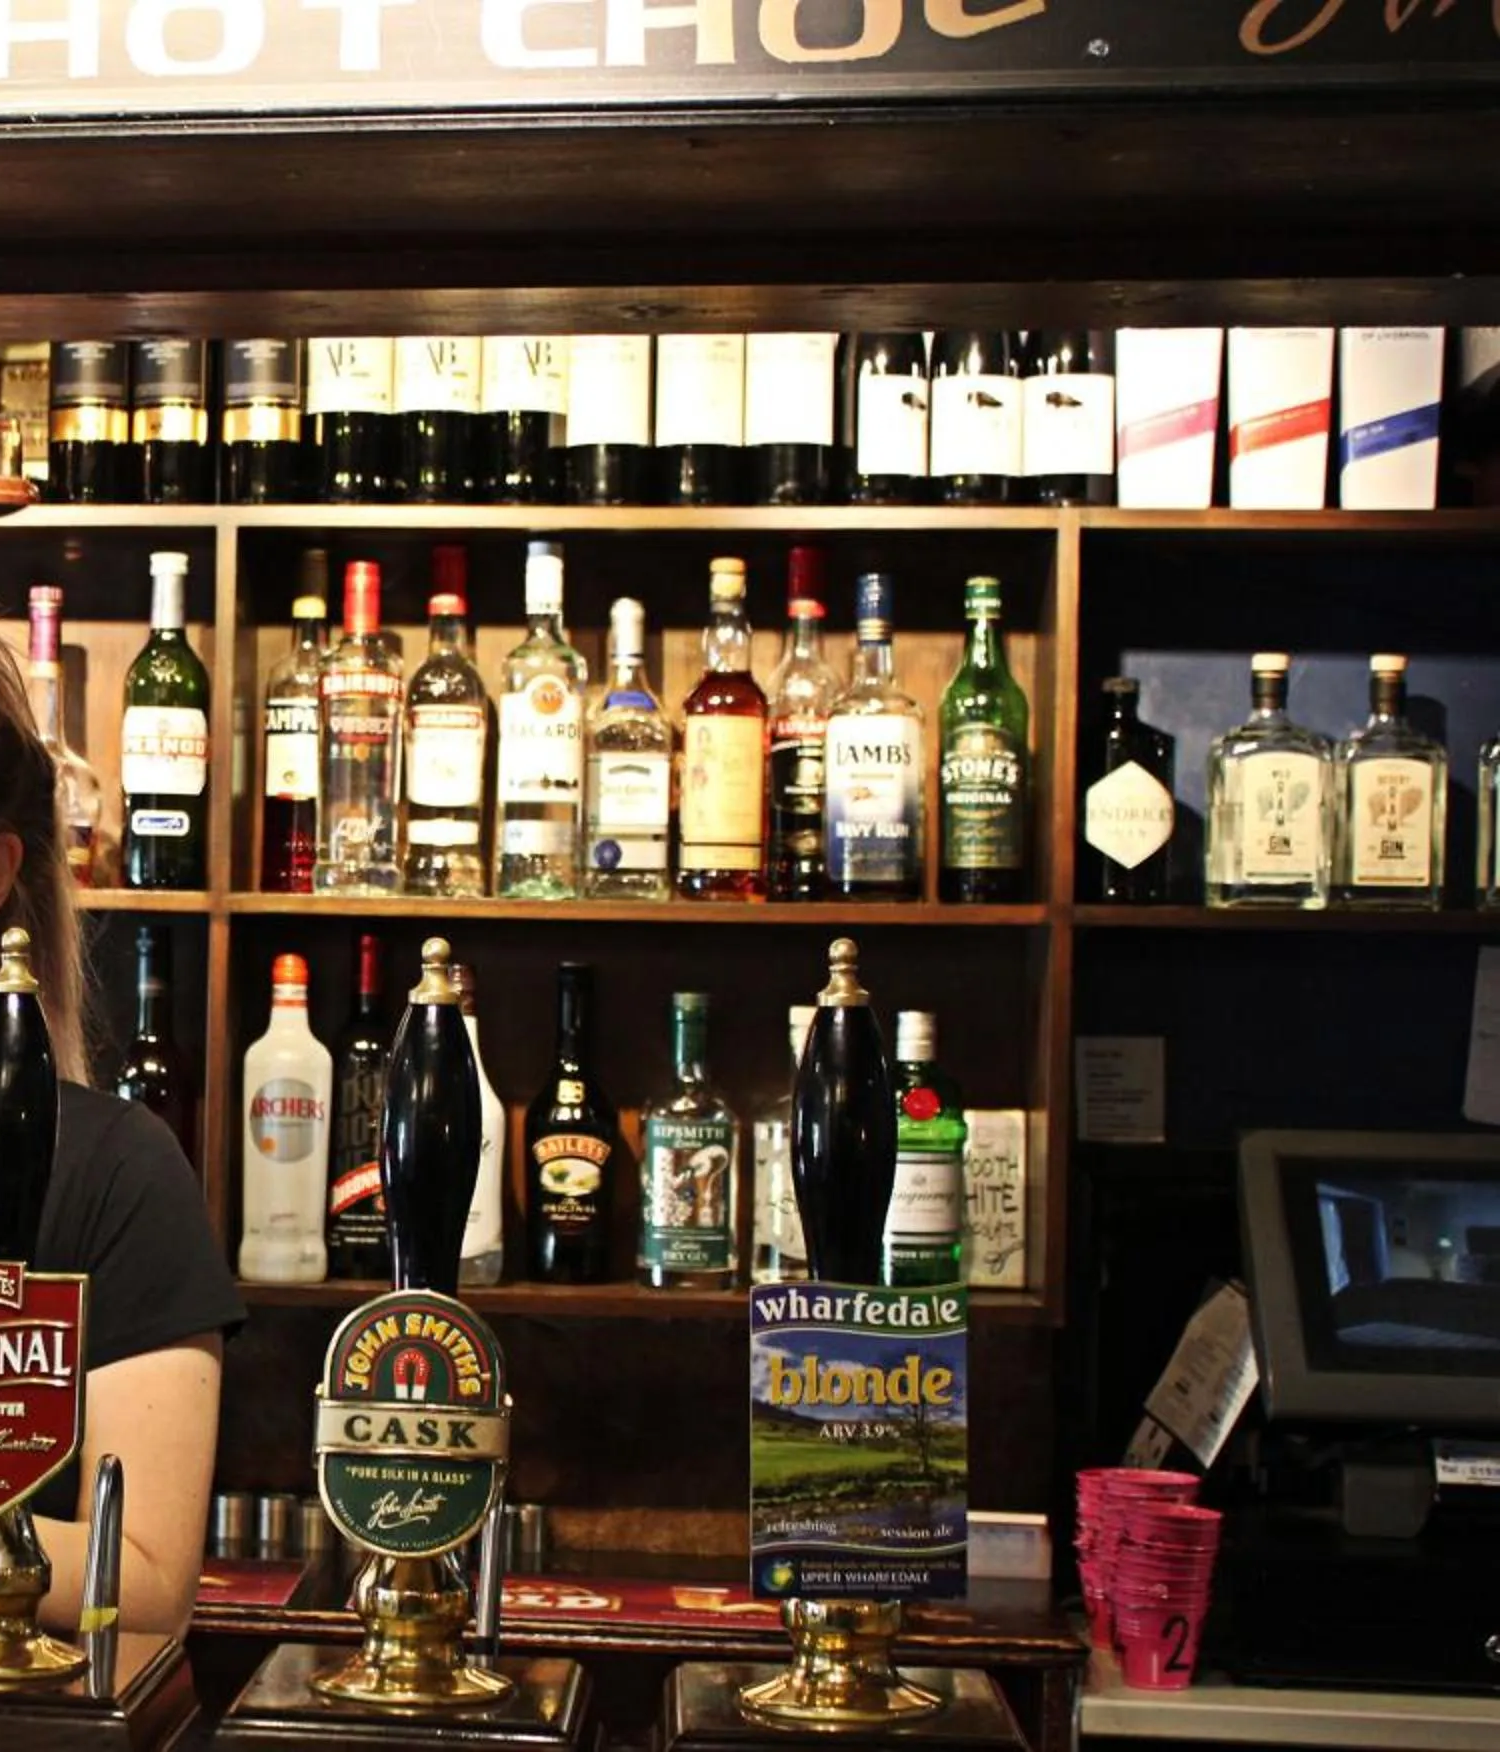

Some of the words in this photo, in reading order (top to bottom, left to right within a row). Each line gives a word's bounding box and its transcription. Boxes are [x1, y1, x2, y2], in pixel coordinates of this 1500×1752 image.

[265, 707, 319, 732] AMPA
[836, 741, 912, 766] LAMB'S
[250, 1096, 326, 1121] ARCHERS
[965, 1182, 1019, 1215] HITE
[755, 1288, 962, 1328] wharfedale
[343, 1314, 402, 1392] JOHN
[404, 1312, 492, 1397] SMITH'S
[767, 1352, 955, 1408] blonde
[343, 1413, 479, 1449] CASK
[819, 1423, 858, 1439] ABV
[859, 1423, 901, 1439] 3.9%
[380, 1467, 405, 1482] SILK
[406, 1470, 420, 1482] IN
[421, 1471, 430, 1482] A
[764, 1518, 838, 1537] refreshing
[880, 1526, 932, 1540] session
[932, 1523, 955, 1538] ale
[801, 1571, 842, 1584] UPPER
[844, 1571, 932, 1584] WHARFEDALE
[1161, 1614, 1193, 1675] 2
